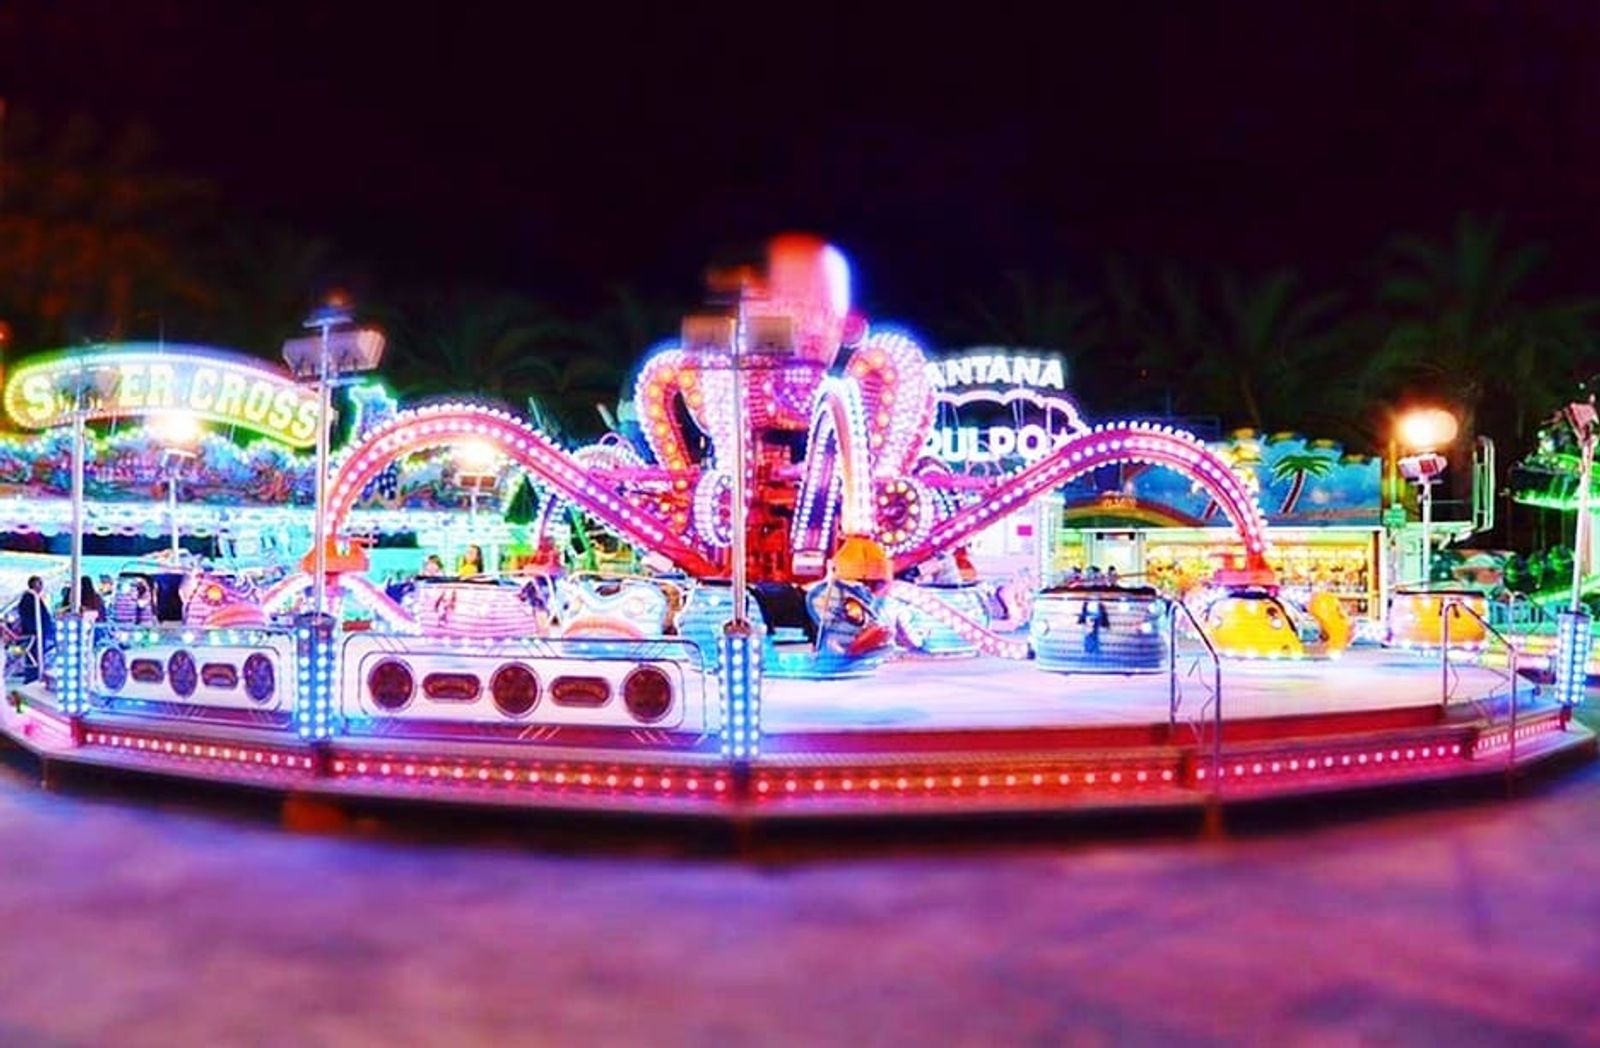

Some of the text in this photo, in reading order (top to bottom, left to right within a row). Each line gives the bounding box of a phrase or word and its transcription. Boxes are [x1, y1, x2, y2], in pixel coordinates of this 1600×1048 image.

[23, 362, 320, 439] SER CROSS
[923, 355, 1064, 390] ANTANA
